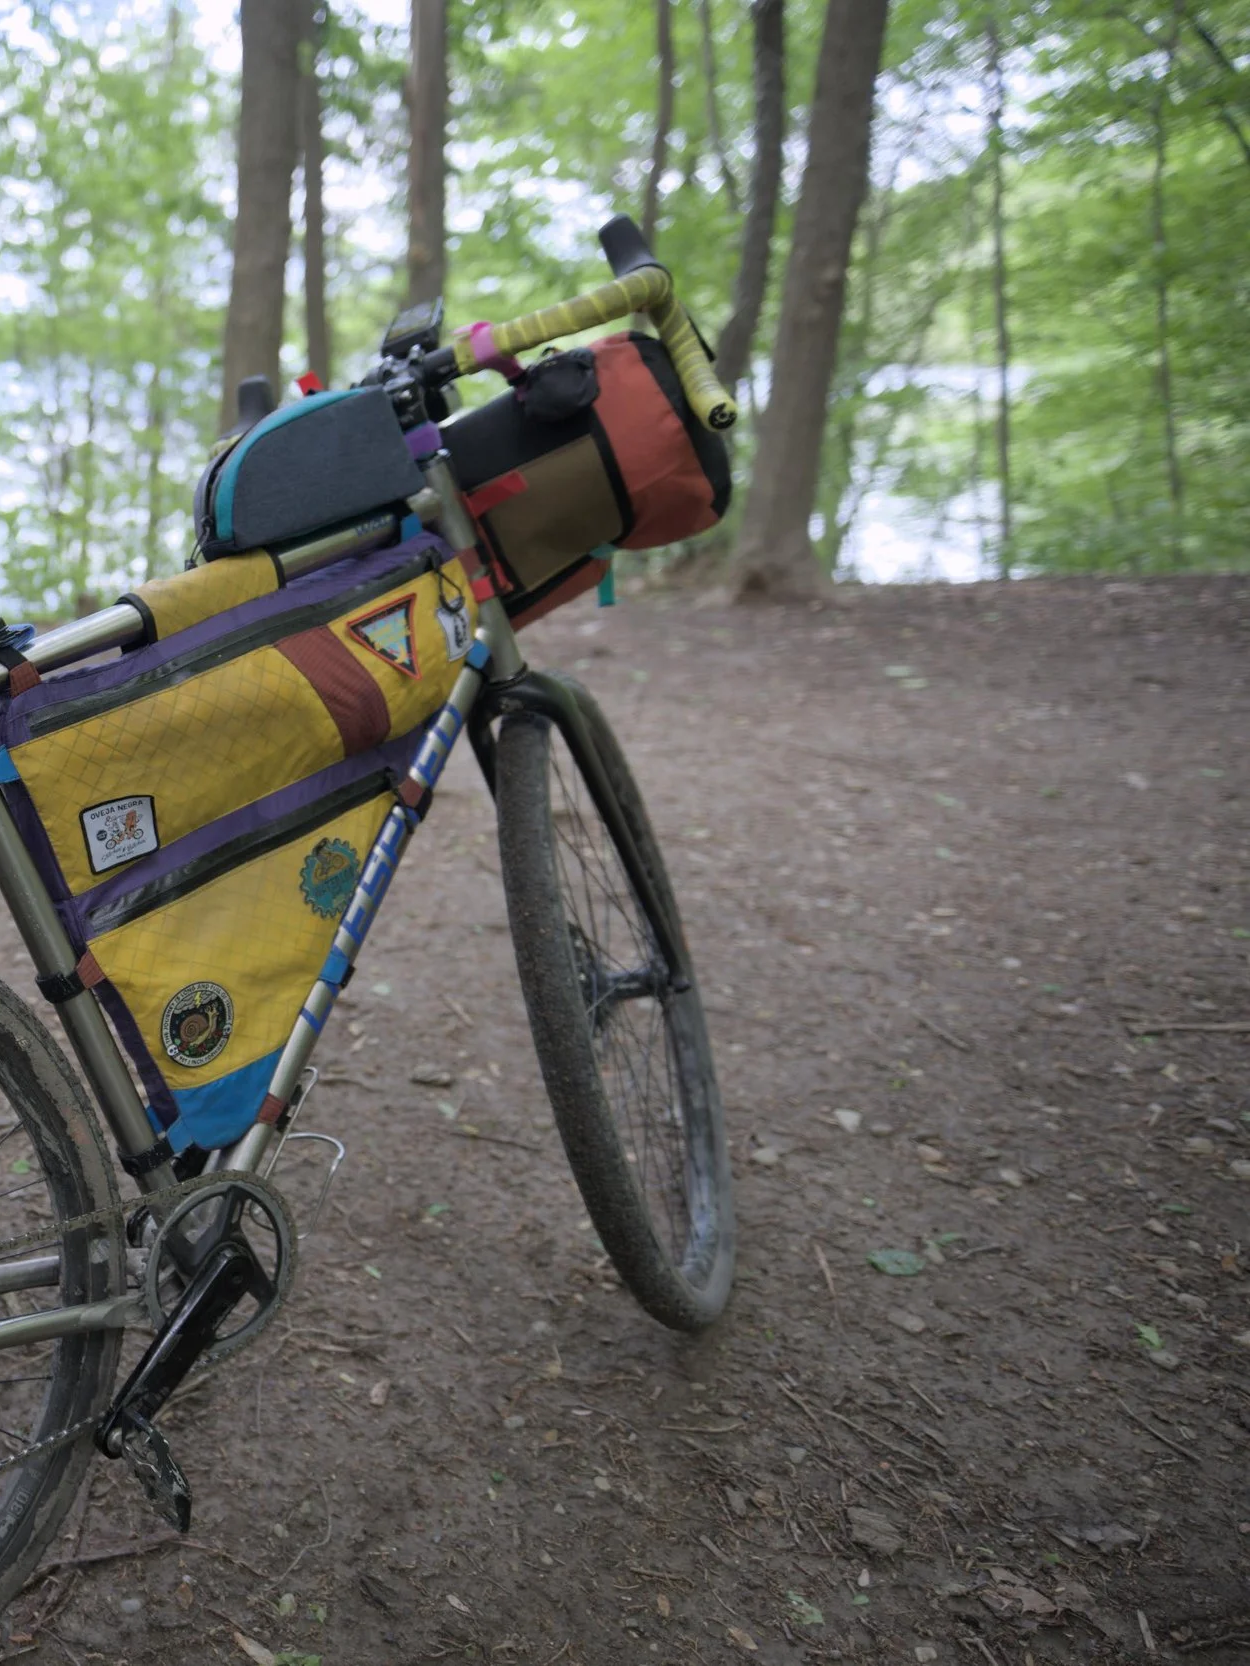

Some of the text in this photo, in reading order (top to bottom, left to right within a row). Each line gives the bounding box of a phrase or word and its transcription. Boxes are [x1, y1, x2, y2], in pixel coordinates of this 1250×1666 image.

[91, 800, 144, 820] OVEJA NEGRA
[301, 702, 463, 1036] LESPED
